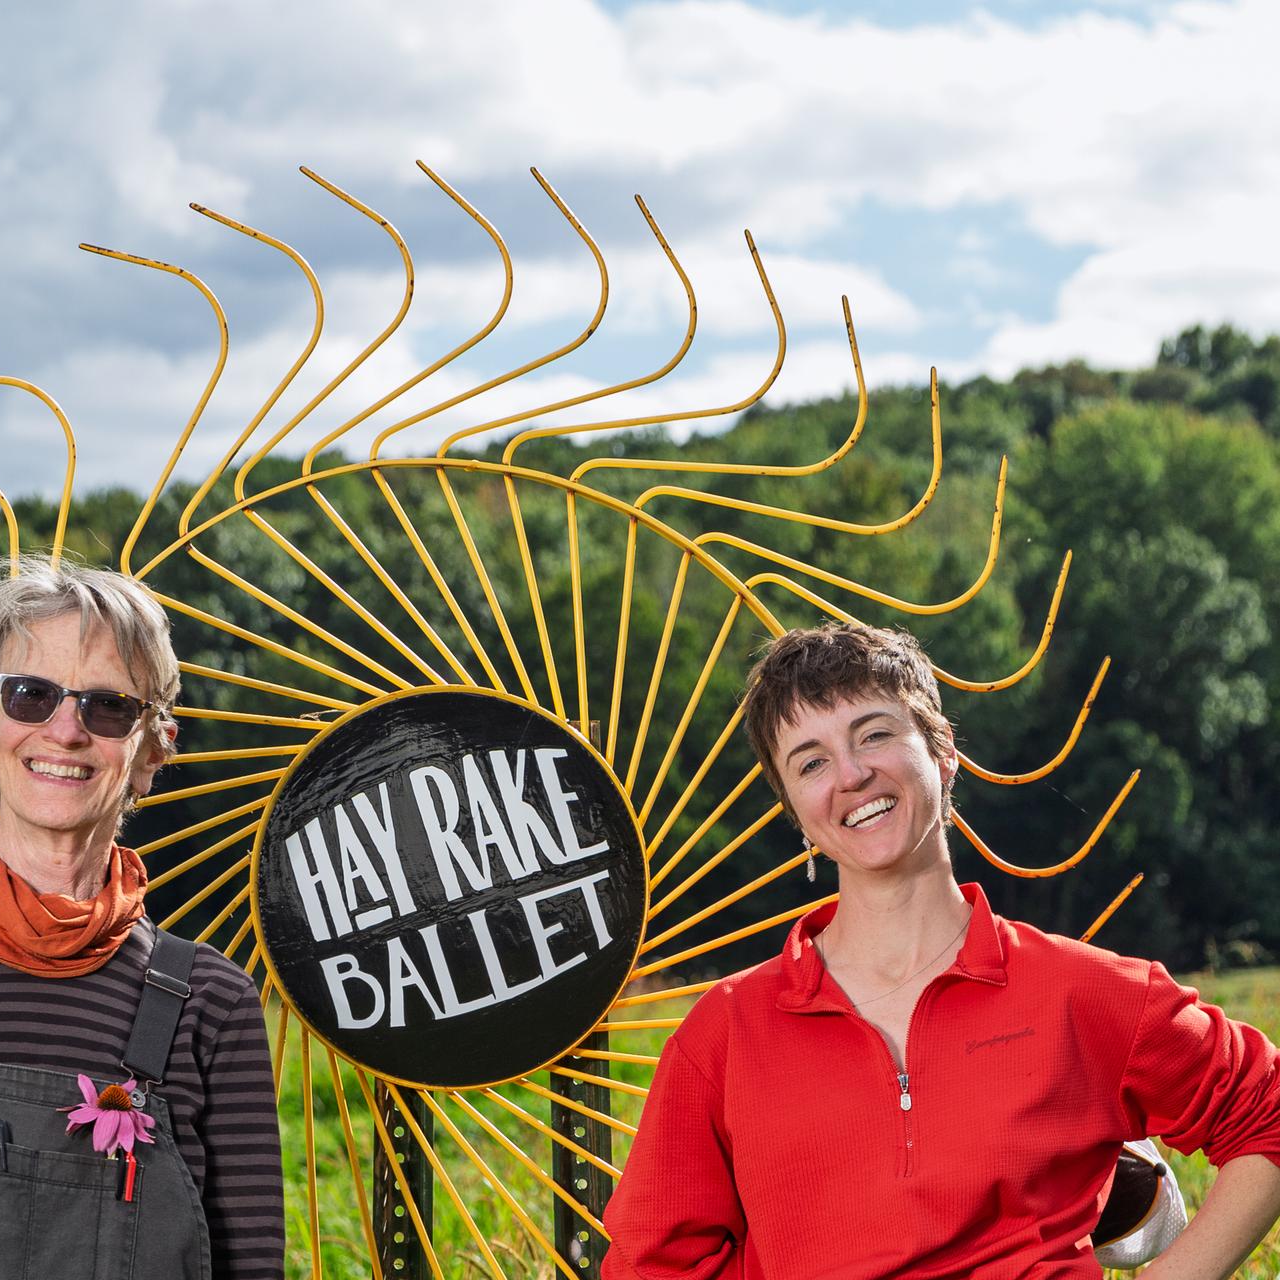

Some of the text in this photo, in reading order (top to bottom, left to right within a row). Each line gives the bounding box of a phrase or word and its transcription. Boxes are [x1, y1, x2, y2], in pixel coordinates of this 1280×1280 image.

[285, 748, 610, 942] HAY RAKE
[319, 869, 614, 1029] BALLET
